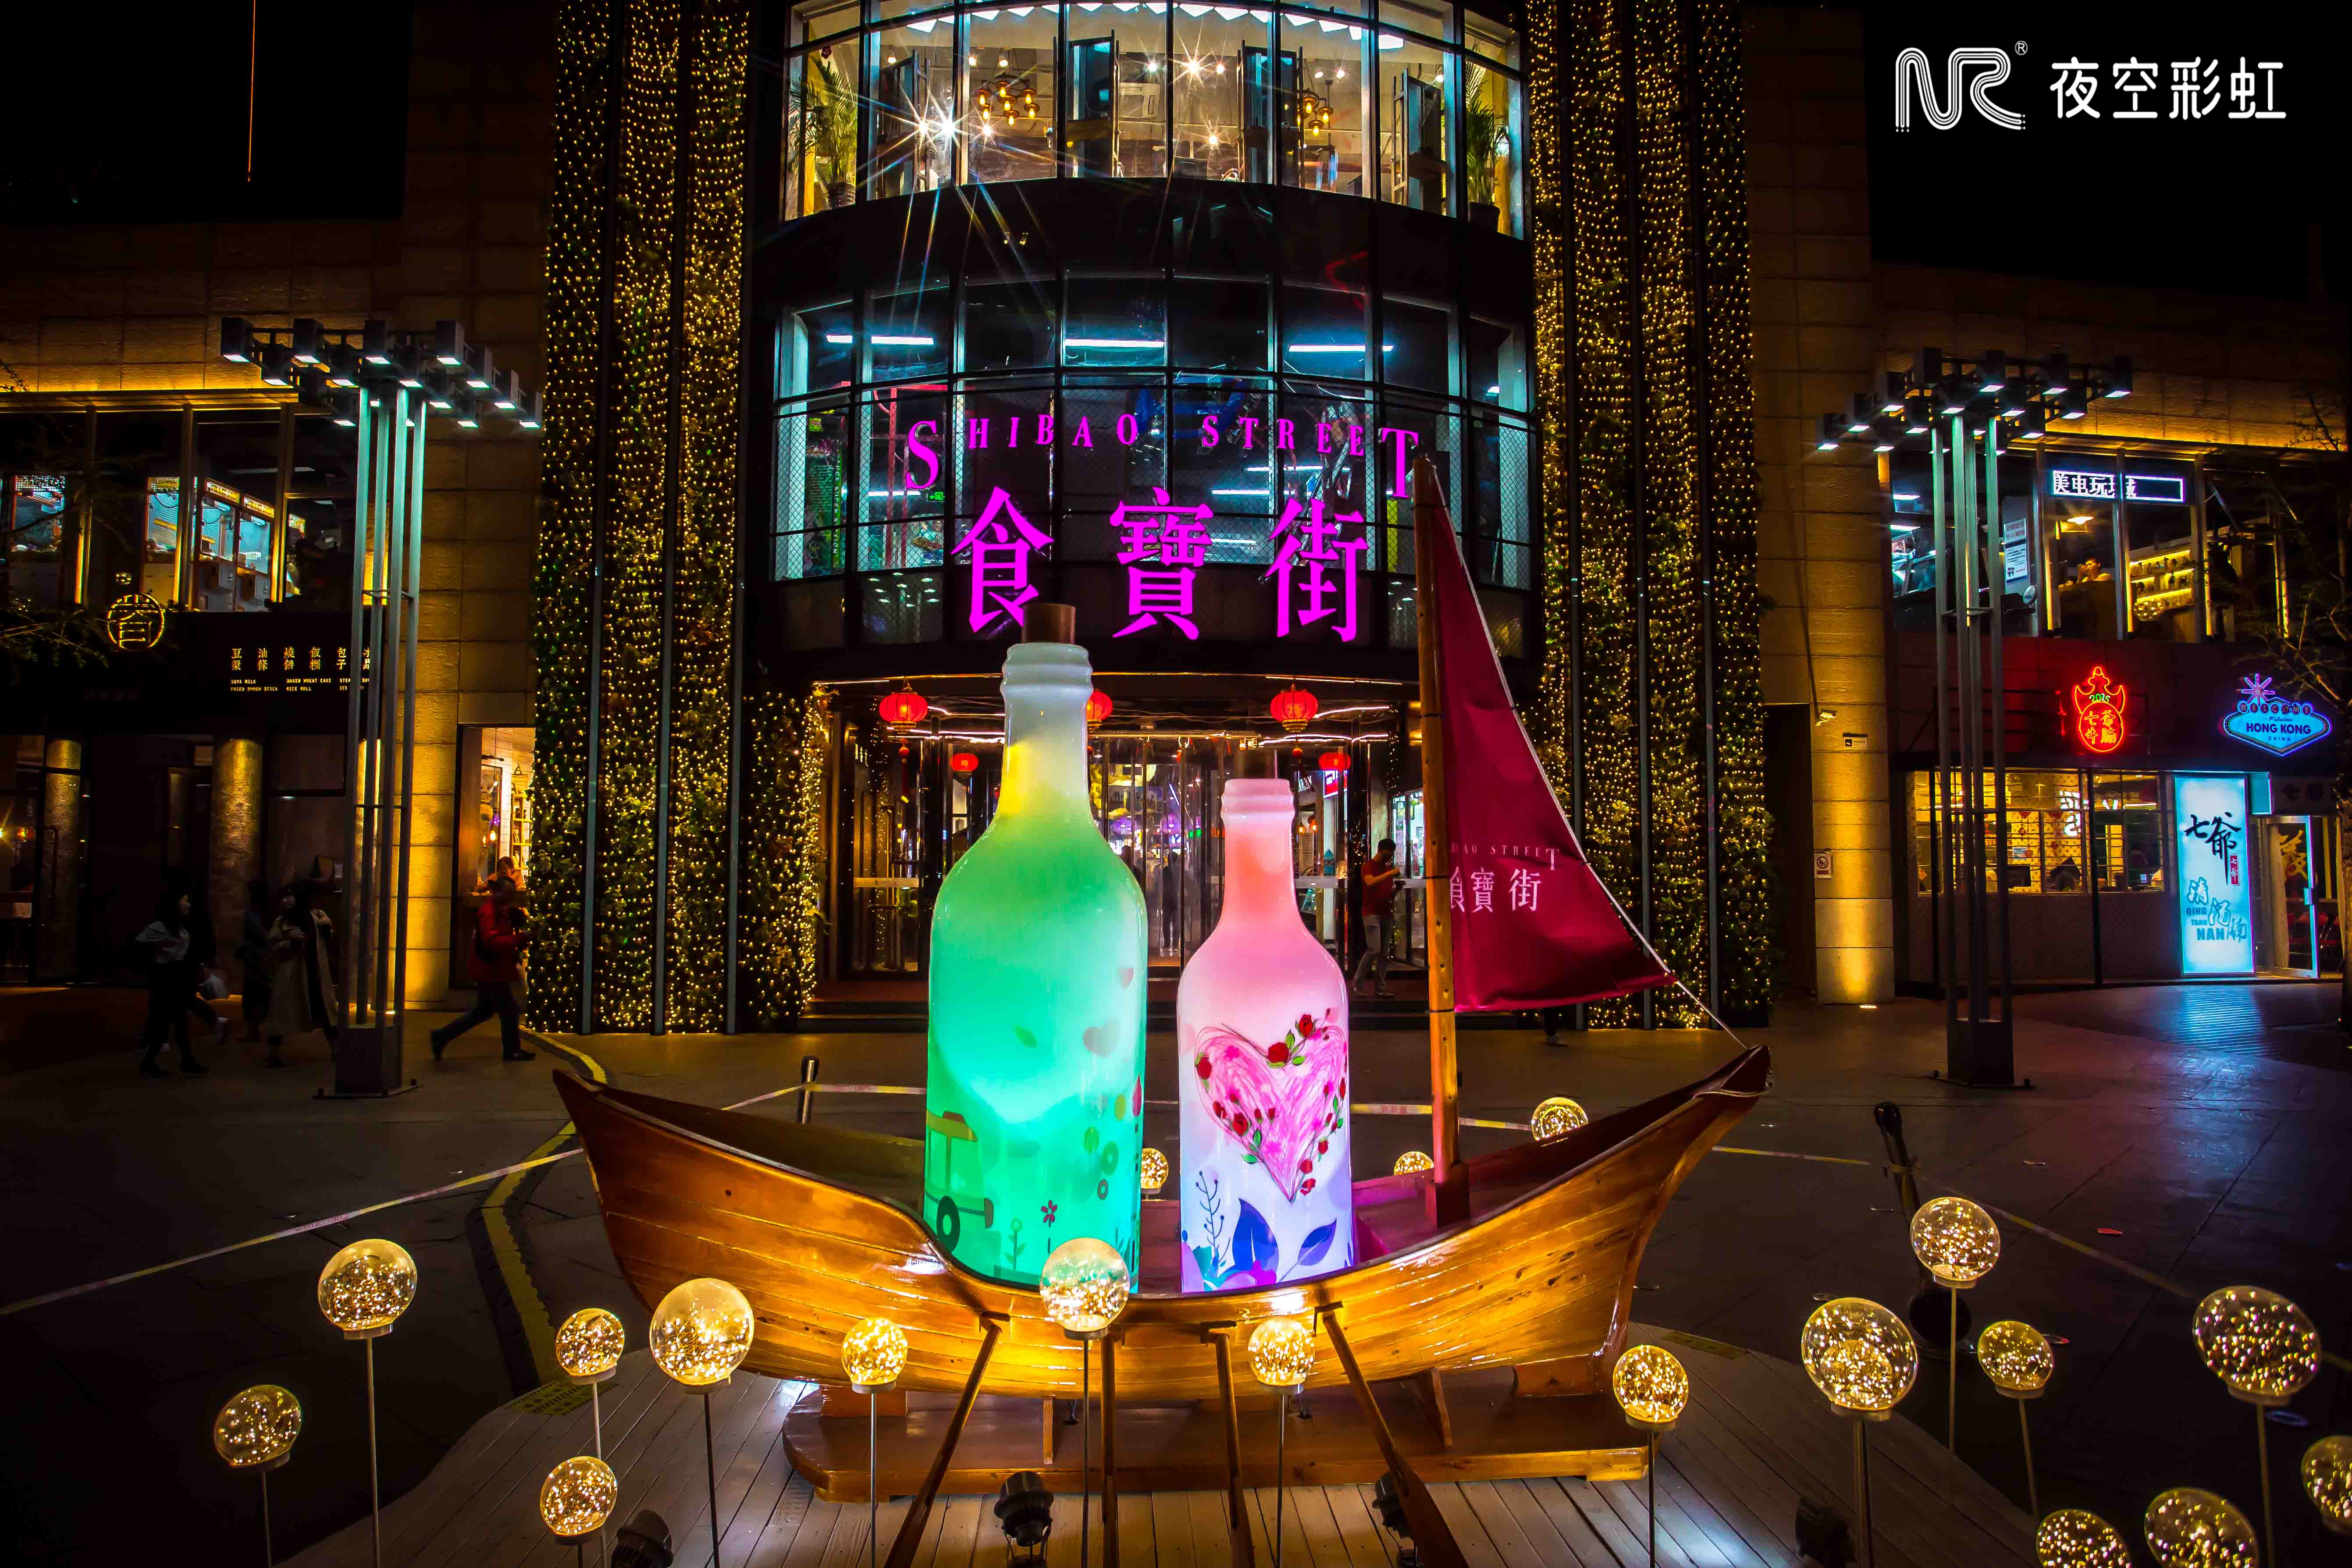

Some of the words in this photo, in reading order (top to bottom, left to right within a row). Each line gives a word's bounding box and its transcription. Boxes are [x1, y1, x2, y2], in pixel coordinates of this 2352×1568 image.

[906, 414, 1138, 489] SHIBAO
[1202, 415, 1419, 498] STREET
[950, 486, 1369, 642] 食寶街
[2240, 702, 2310, 714] WELCOME
[2246, 723, 2278, 733] HONG
[2281, 724, 2312, 734] KONG
[1491, 845, 1559, 871] STREET
[2186, 907, 2207, 916] QING
[2196, 928, 2224, 940] NAN
